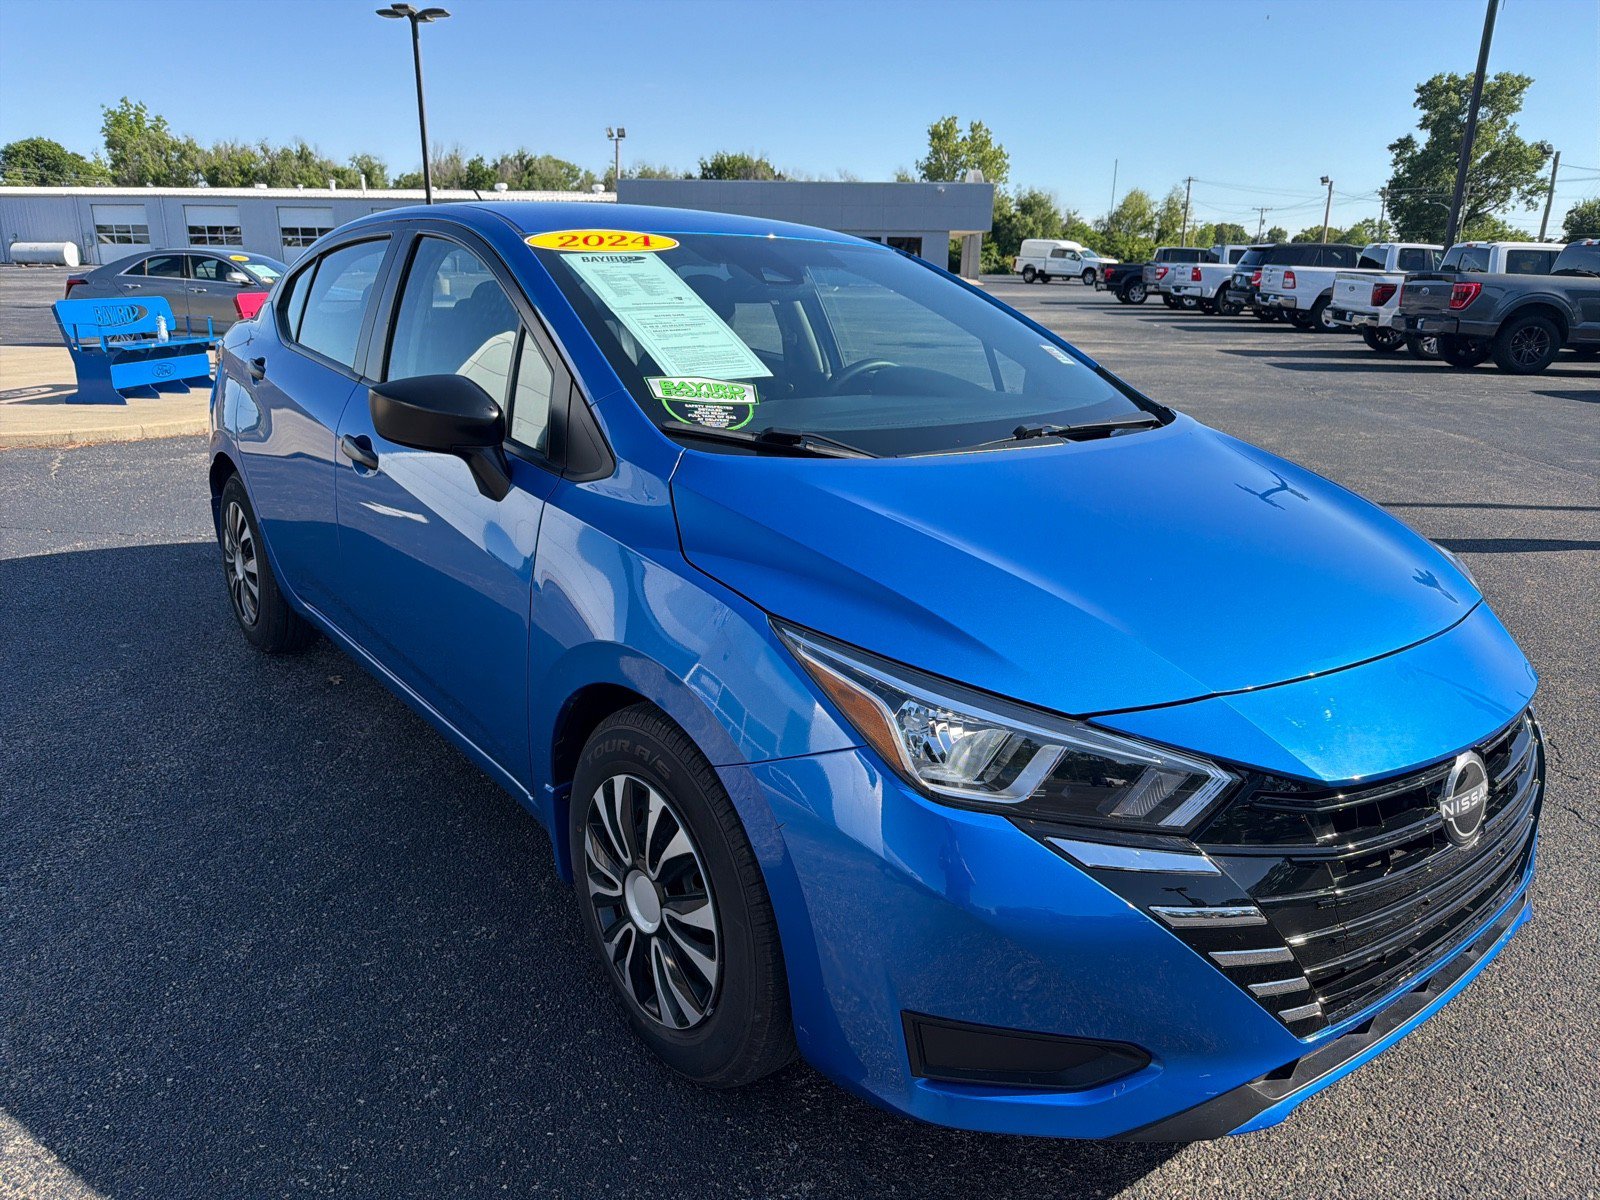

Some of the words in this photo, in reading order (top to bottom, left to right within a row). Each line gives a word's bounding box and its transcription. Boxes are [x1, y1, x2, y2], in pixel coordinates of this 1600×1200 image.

[558, 234, 655, 247] 2024
[581, 255, 628, 263] BAYIRD
[659, 380, 746, 395] BAYIRD
[661, 389, 747, 400] ECONOMY
[588, 740, 630, 766] TOUR
[1442, 787, 1485, 817] NISSA
